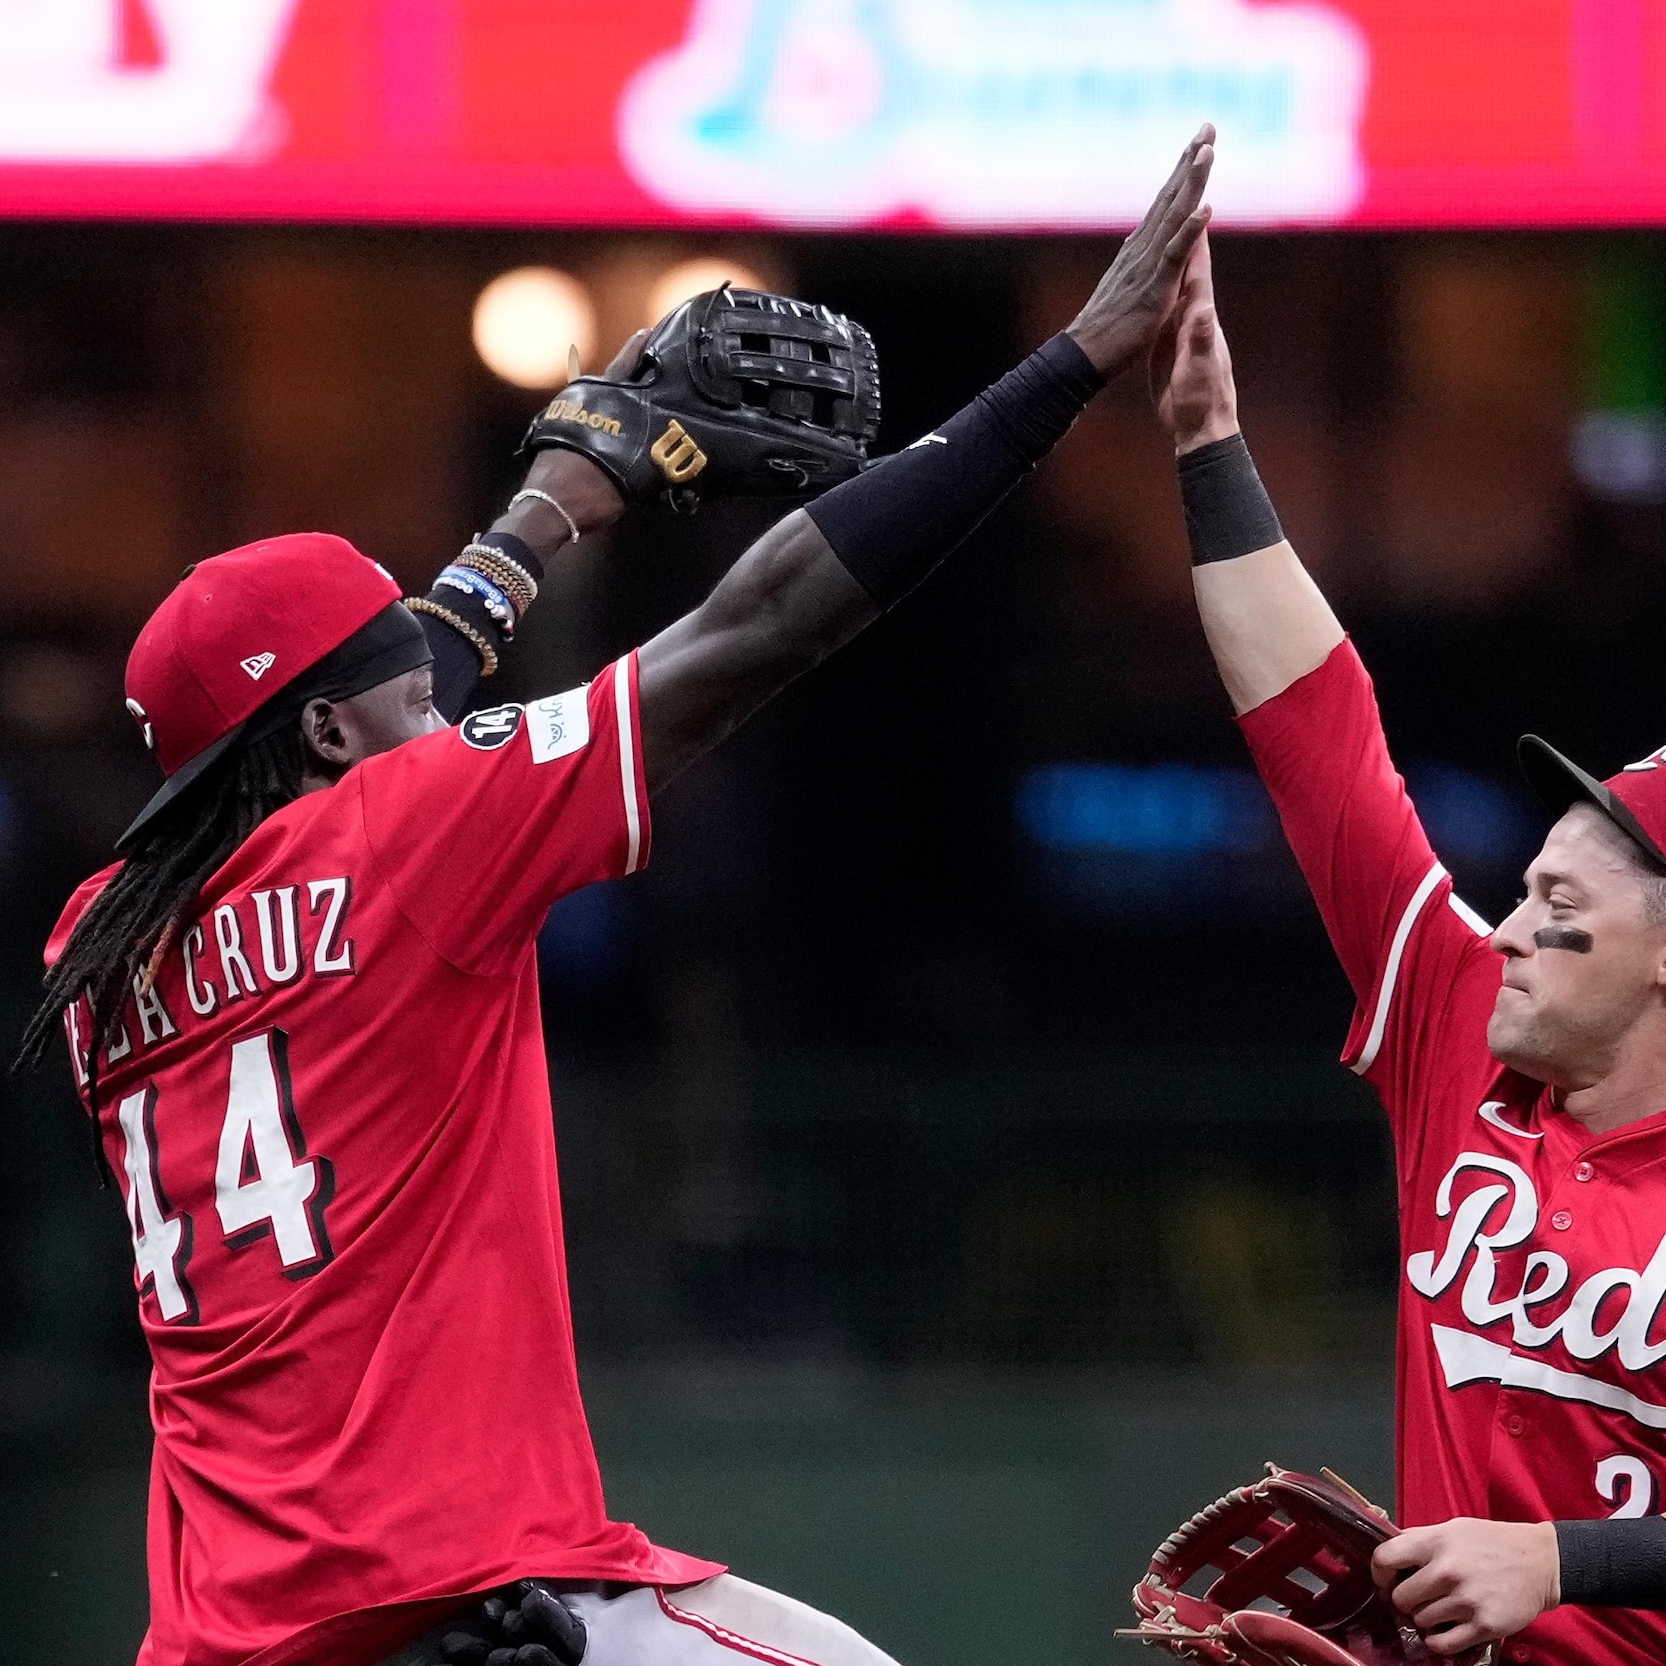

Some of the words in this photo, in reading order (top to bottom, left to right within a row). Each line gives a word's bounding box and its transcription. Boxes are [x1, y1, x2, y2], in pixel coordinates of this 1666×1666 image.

[543, 398, 623, 438] Wilson
[471, 710, 517, 739] 14
[182, 875, 356, 1017] CRUZ
[118, 1026, 334, 1325] 44
